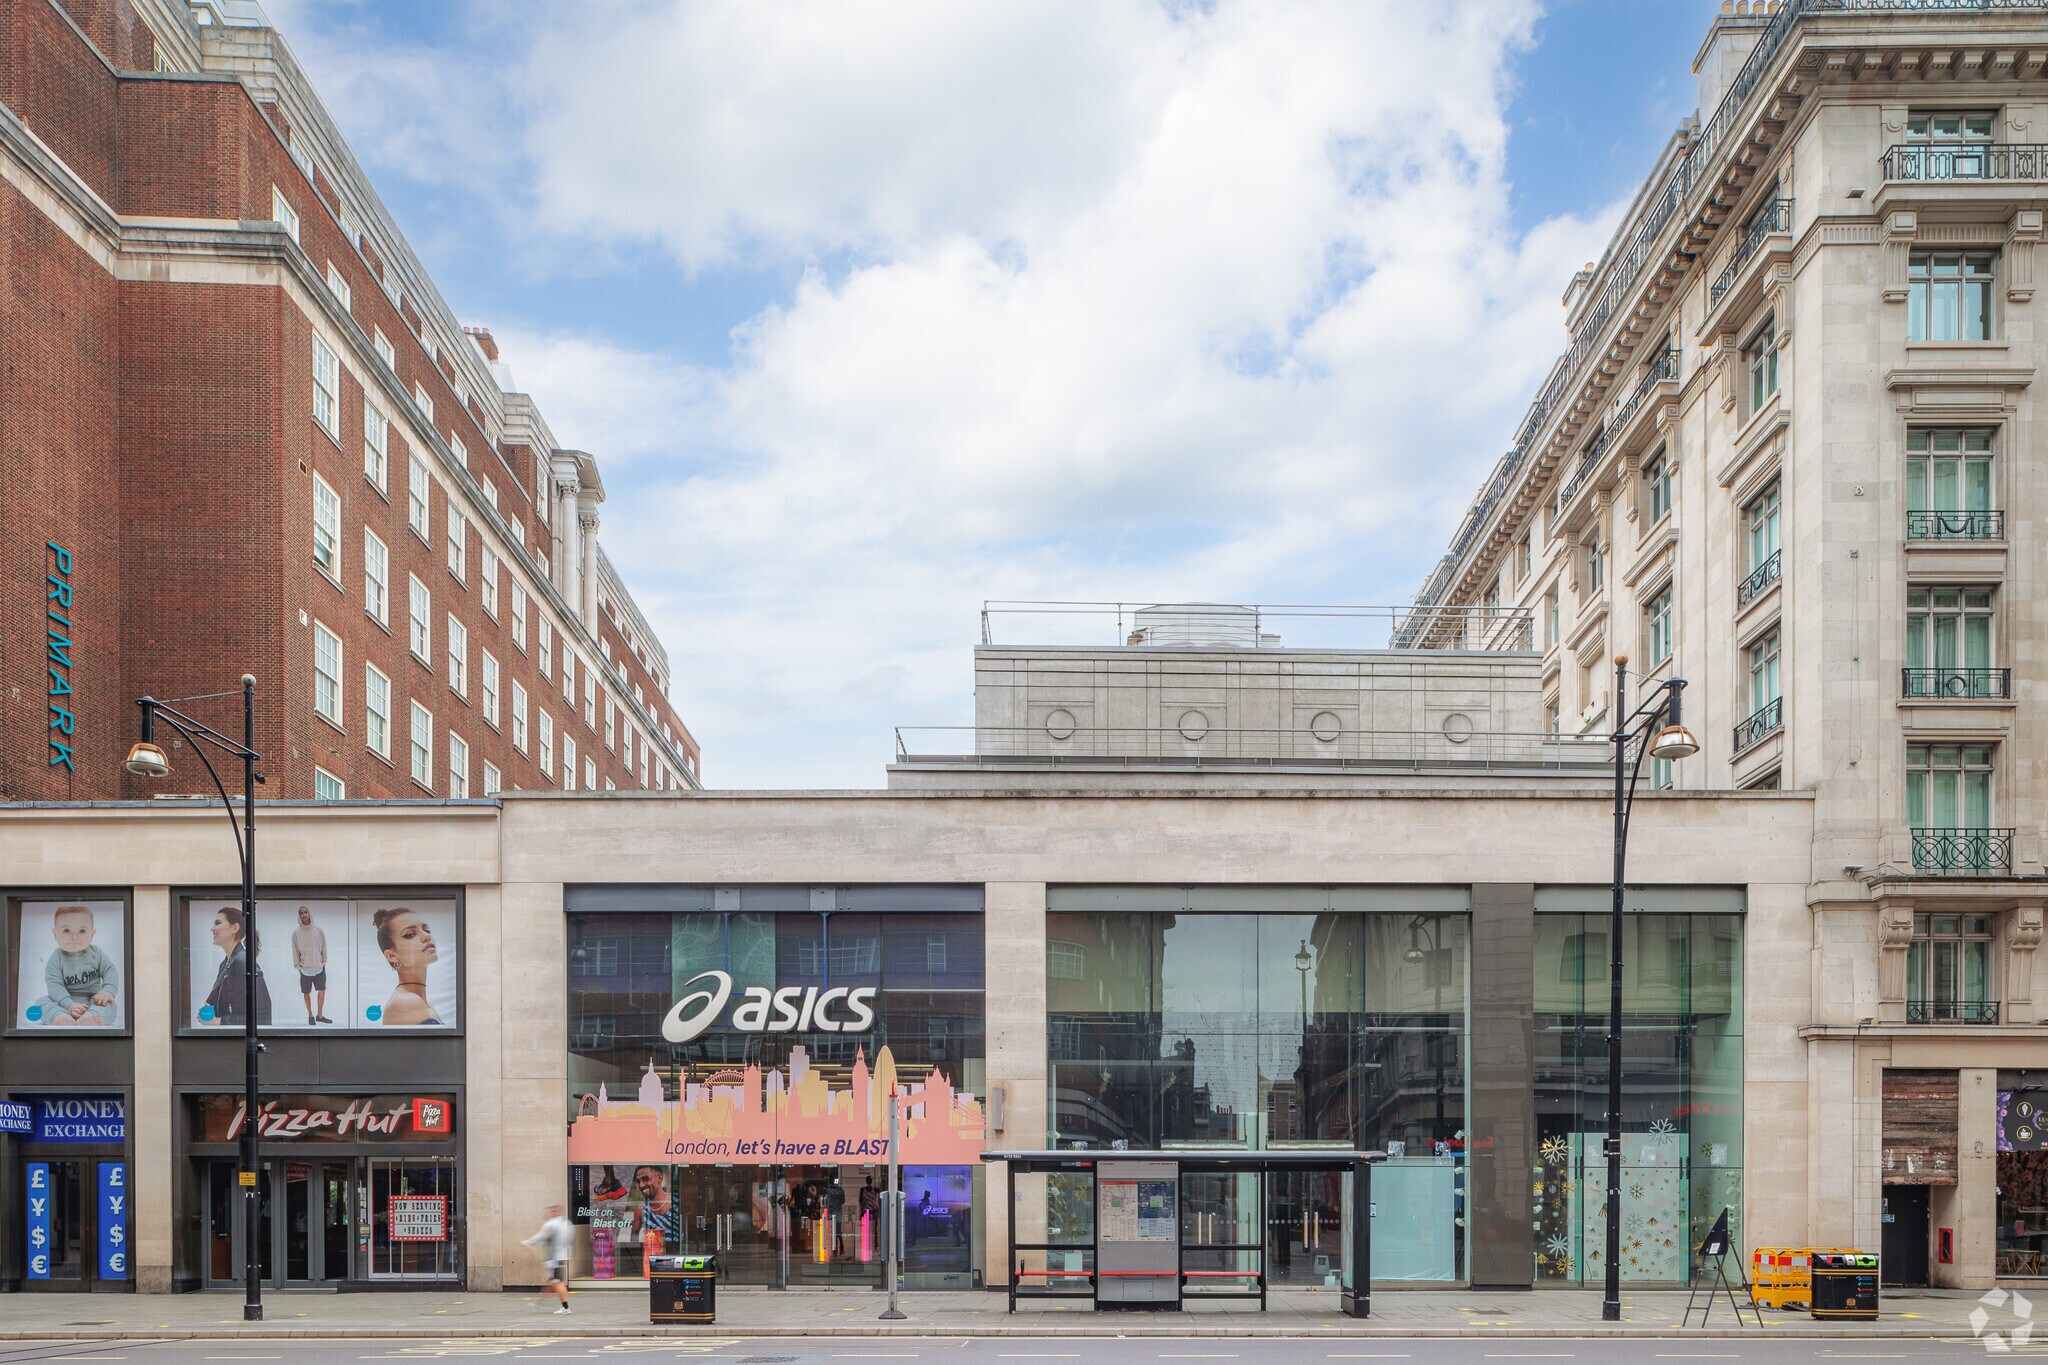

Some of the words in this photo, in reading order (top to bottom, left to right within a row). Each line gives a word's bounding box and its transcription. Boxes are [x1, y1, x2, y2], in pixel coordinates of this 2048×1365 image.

[47, 541, 75, 773] PRIMARK
[44, 1100, 125, 1118] MONEY
[423, 1104, 441, 1117] Pizza
[336, 1100, 415, 1135] Hut
[425, 1114, 440, 1127] Hut
[665, 1138, 731, 1157] London,
[735, 1139, 771, 1156] let's
[774, 1139, 816, 1156] have
[819, 1144, 830, 1156] a
[833, 1139, 890, 1156] BLAST
[394, 1202, 408, 1210] NOW
[411, 1202, 441, 1210] SERVING
[577, 1206, 599, 1217] Blast
[601, 1209, 615, 1217] on.
[592, 1218, 616, 1228] Blast
[617, 1218, 633, 1228] off.
